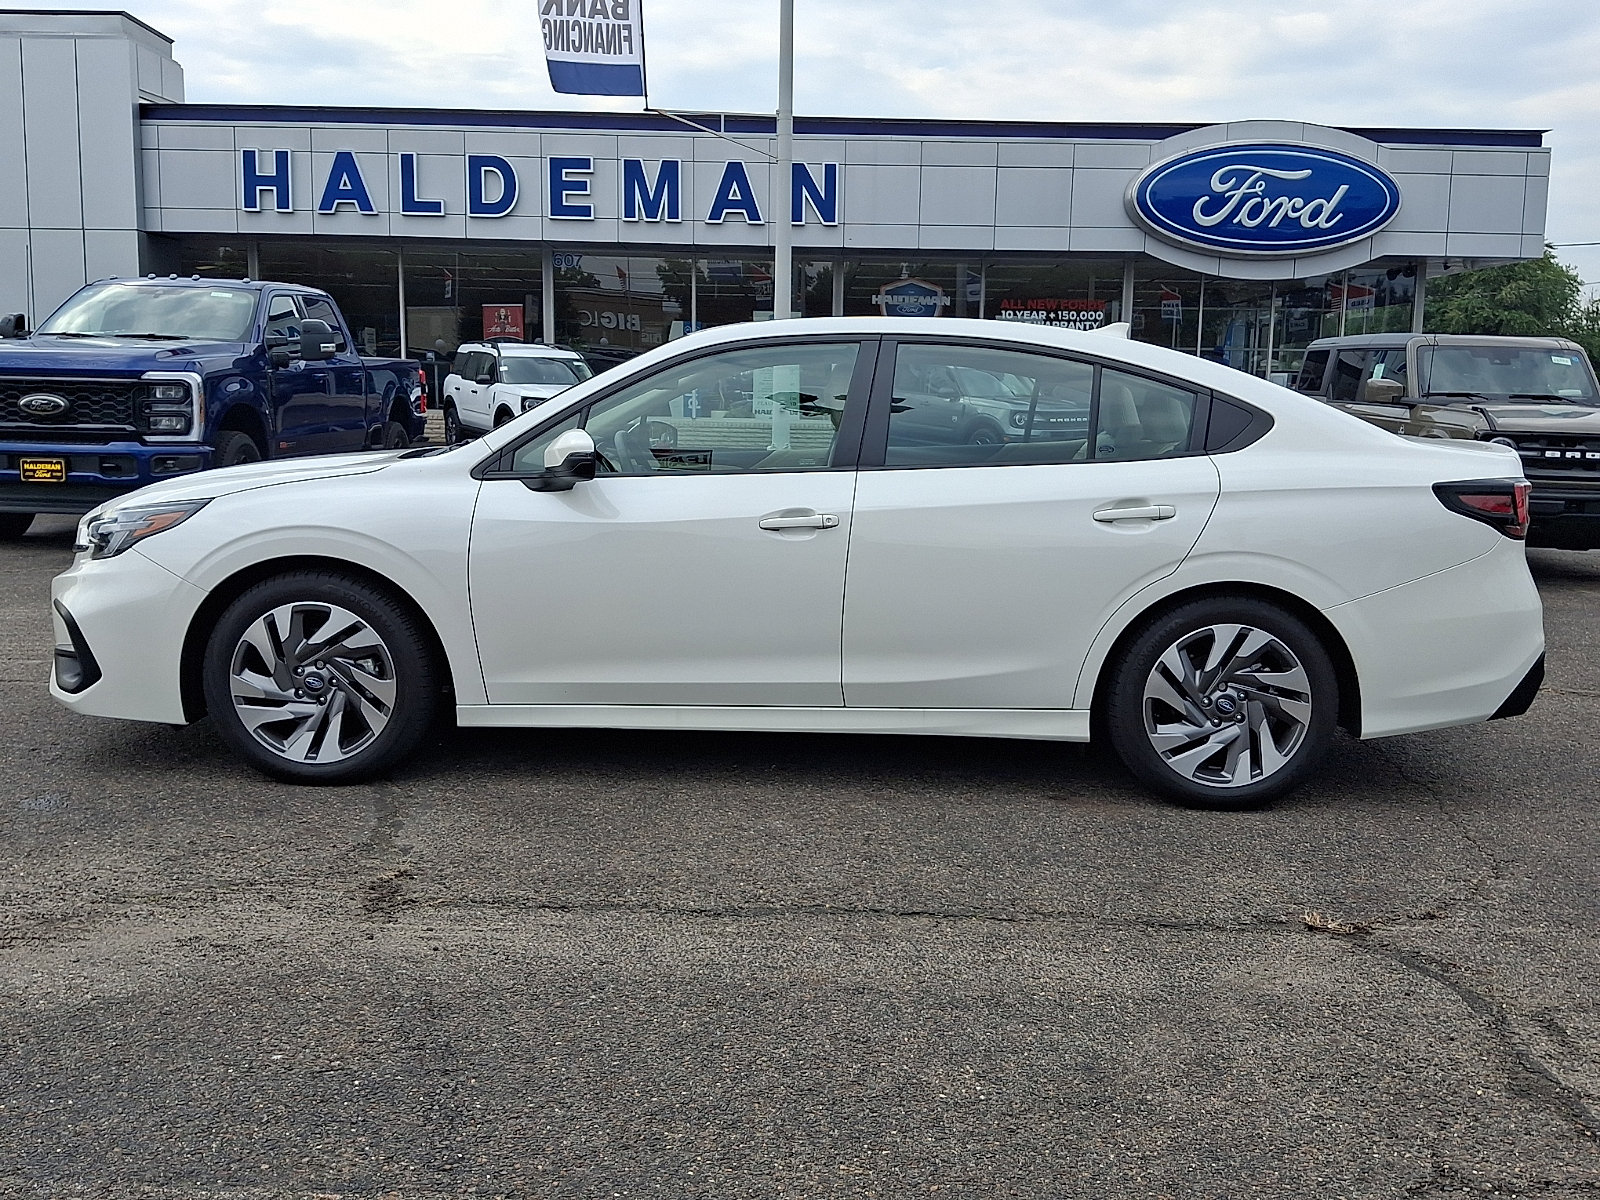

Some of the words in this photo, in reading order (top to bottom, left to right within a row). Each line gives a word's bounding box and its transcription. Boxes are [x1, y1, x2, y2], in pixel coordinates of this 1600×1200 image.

[240, 147, 839, 226] HALDEMAN
[1193, 164, 1349, 229] Ford
[553, 253, 583, 268] 607
[871, 294, 951, 306] HALDEMAN
[1000, 299, 1025, 310] ALL
[1027, 299, 1059, 310] NEW
[1000, 310, 1014, 320] 10
[1015, 310, 1047, 321] YEAR
[1057, 310, 1104, 322] 150,000
[30, 399, 55, 410] Ford
